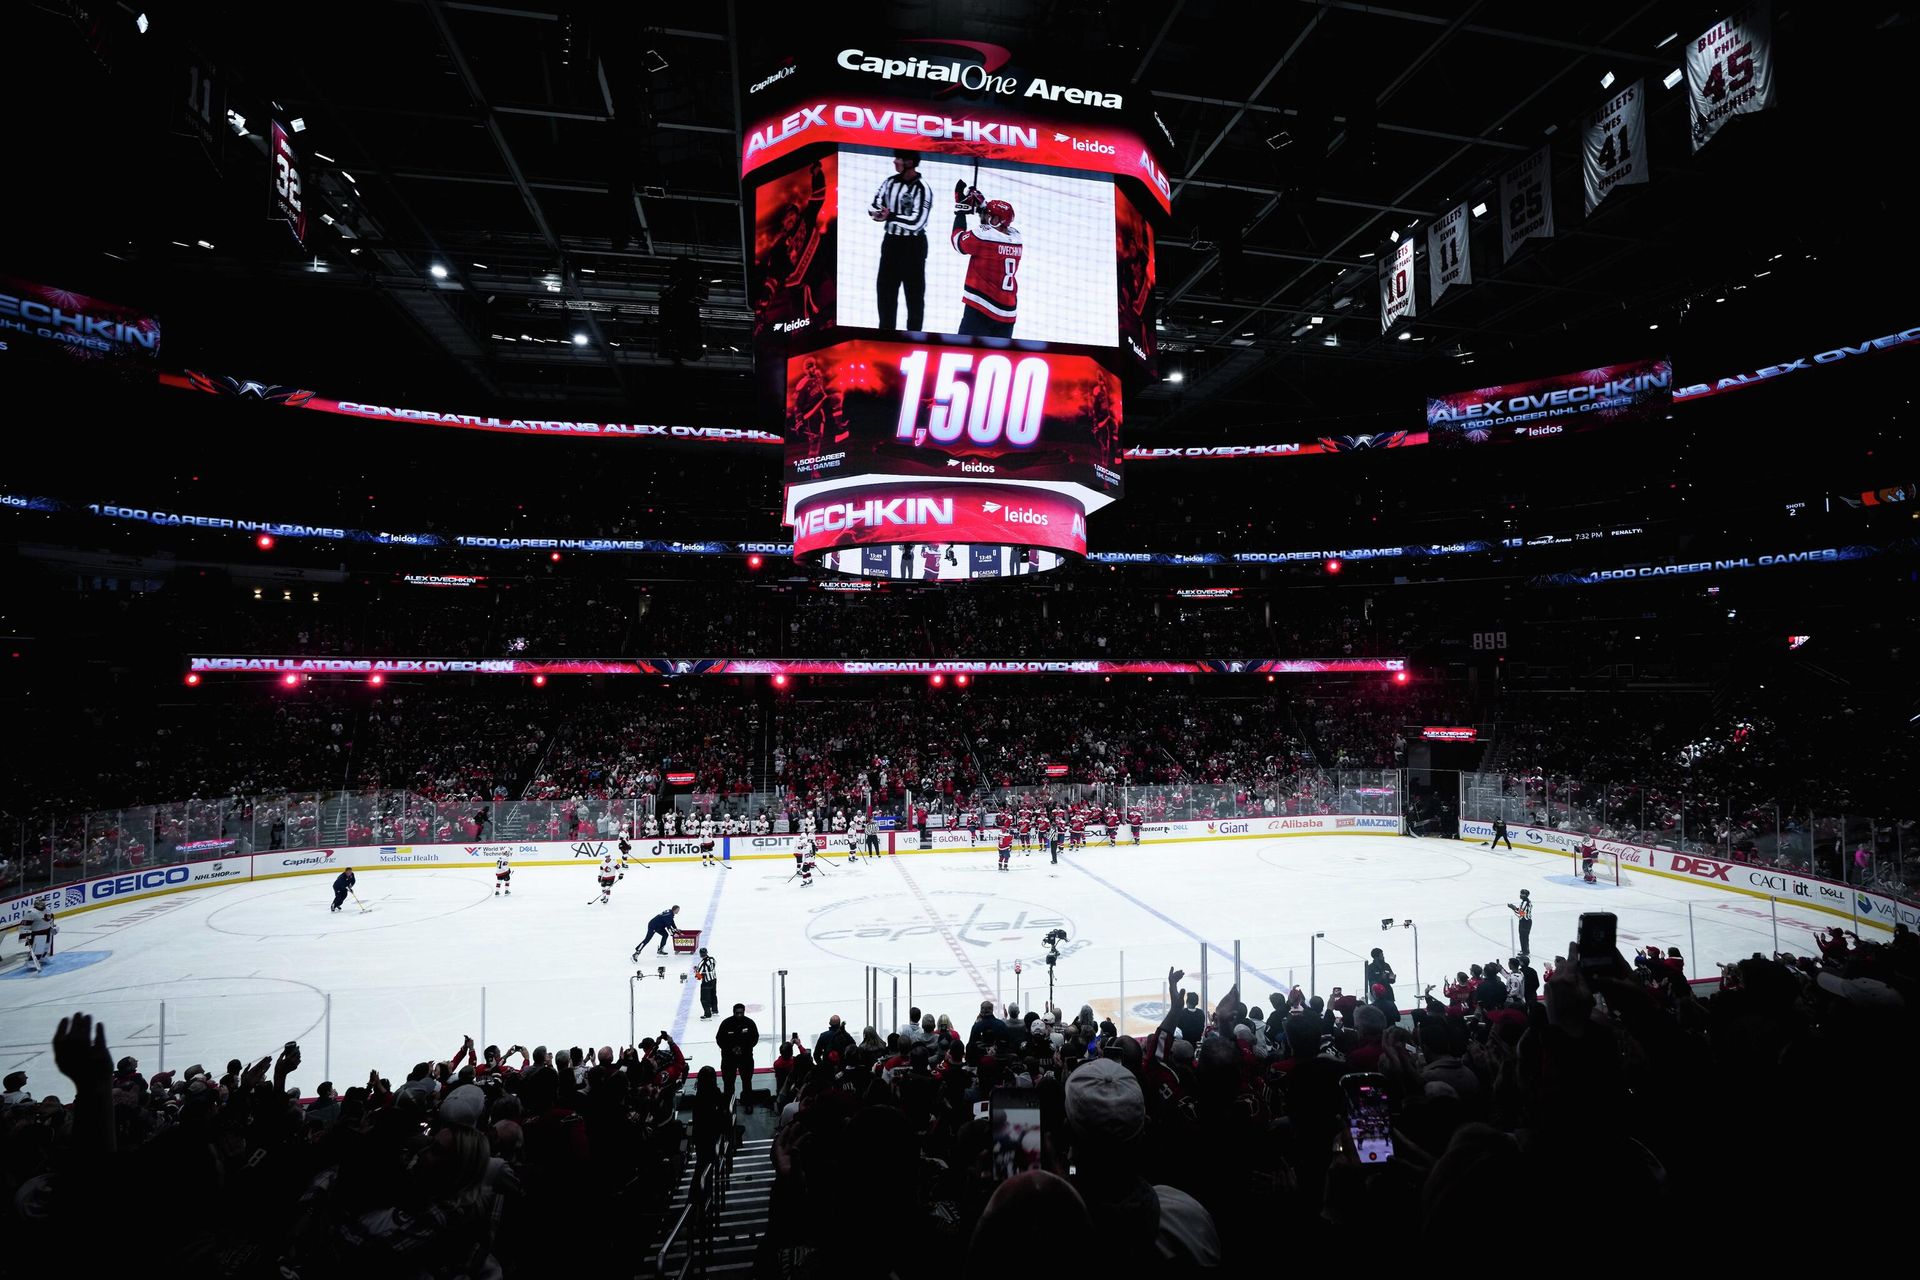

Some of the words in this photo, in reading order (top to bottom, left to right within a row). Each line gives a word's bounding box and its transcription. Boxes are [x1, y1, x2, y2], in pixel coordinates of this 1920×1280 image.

[1715, 34, 1741, 59] PHIL
[1703, 41, 1753, 104] 45
[1024, 77, 1123, 109] Arena
[747, 104, 828, 157] ALEX
[834, 105, 1037, 149] OVECHKIN
[1072, 137, 1116, 155] leidos
[1598, 124, 1631, 171] 41
[277, 153, 302, 213] 32
[1510, 182, 1543, 230] 25
[1441, 237, 1458, 273] 11
[1001, 258, 1016, 292] 8
[1388, 270, 1407, 304] 10
[784, 317, 810, 333] leidos
[37, 327, 111, 352] GAMES
[1716, 357, 1813, 390] ALEX
[896, 350, 1050, 447] 1,500
[1432, 400, 1505, 424] ALEX
[1508, 372, 1669, 413] OVECHKIN
[338, 401, 600, 433] CONGRATULATIONS
[603, 422, 669, 436] ALEX
[1495, 410, 1548, 426] CAREER
[1550, 406, 1598, 417] NHL
[1599, 396, 1653, 411] GAMES
[1528, 424, 1564, 437] leidos
[815, 452, 846, 463] CAREER
[1125, 444, 1183, 457] ALEX
[1185, 443, 1300, 456] OVECHKIN
[797, 463, 813, 473] NHL
[813, 460, 841, 470] GAMES
[961, 458, 995, 474] leidos
[1785, 502, 1806, 511] SHOTS
[1790, 509, 1797, 517] 2
[1004, 506, 1048, 526] leidos
[152, 511, 234, 529] CAREER
[237, 520, 276, 531] NHL
[280, 524, 345, 539] GAMES
[391, 534, 418, 543] leidos
[1591, 532, 1604, 540] PM
[499, 538, 559, 548] CAREER
[560, 539, 588, 549] NHL
[592, 541, 645, 551] GAMES
[682, 543, 705, 552] leidos
[1441, 543, 1466, 553] leidos
[1109, 553, 1151, 561] GAMES
[1183, 554, 1204, 562] leidos
[1269, 551, 1321, 561] CAREER
[1322, 550, 1348, 559] NHL
[1353, 547, 1403, 557] GAMES
[1639, 562, 1713, 577] CAREER
[1715, 557, 1756, 571] NHL
[1758, 549, 1838, 567] GAMES
[1473, 631, 1506, 650] 899
[374, 659, 422, 671] ALEX
[426, 659, 514, 671] OVECHKIN
[844, 661, 988, 672] CONGRATULATIONS
[990, 661, 1026, 671] ALEX
[1028, 660, 1099, 671] OVECHKIN
[1219, 821, 1249, 834] Giant
[1281, 819, 1324, 829] Alibaba
[1356, 818, 1398, 828] AMAZING
[752, 837, 795, 848] GDIT
[939, 835, 968, 843] GLOBAL
[380, 854, 411, 863] MedStar
[413, 853, 439, 862] Health
[575, 842, 603, 858] AV
[194, 870, 241, 881] NHLSHOP.com
[1670, 855, 1734, 882] DEX
[92, 867, 189, 899] GEICO
[1749, 872, 1787, 892] CACI
[1820, 886, 1845, 900] DELL
